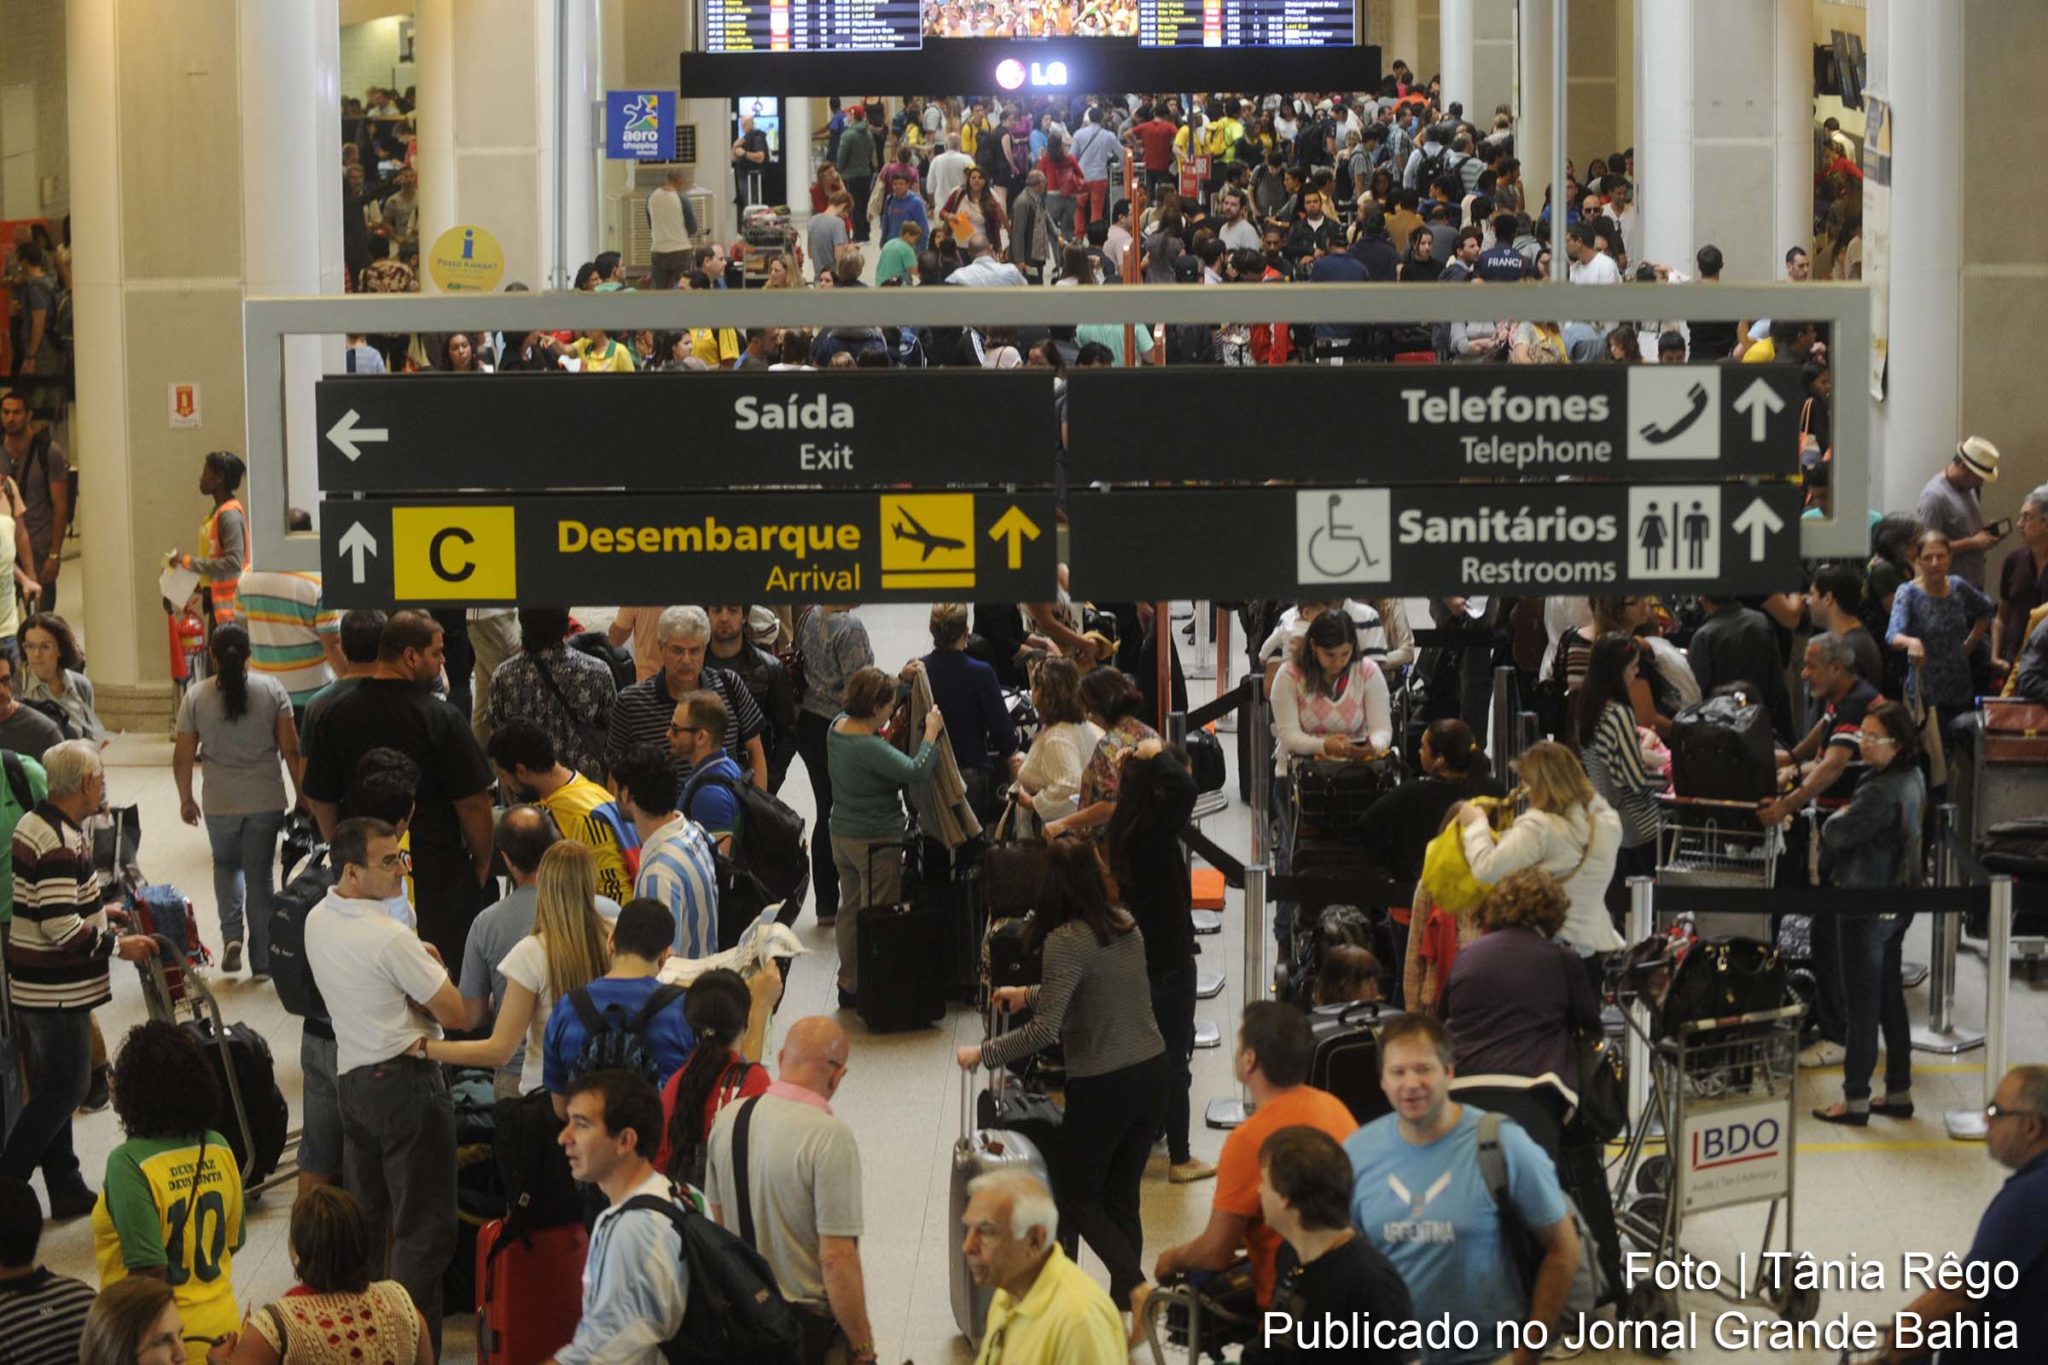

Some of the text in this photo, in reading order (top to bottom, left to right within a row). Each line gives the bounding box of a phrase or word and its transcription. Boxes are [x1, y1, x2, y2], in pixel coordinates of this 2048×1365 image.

[1031, 61, 1067, 86] LG
[623, 131, 658, 142] aero
[734, 393, 855, 430] Saída
[1400, 386, 1610, 423] Telefones
[799, 442, 854, 470] Exit
[1460, 434, 1612, 469] Telephone
[557, 516, 861, 559] Desembarque
[1397, 506, 1618, 544] Sanitários
[430, 527, 476, 583] C
[1461, 556, 1618, 584] Restrooms
[765, 563, 861, 591] Arrival
[1703, 1118, 1779, 1159] BDO
[165, 1190, 226, 1287] 10
